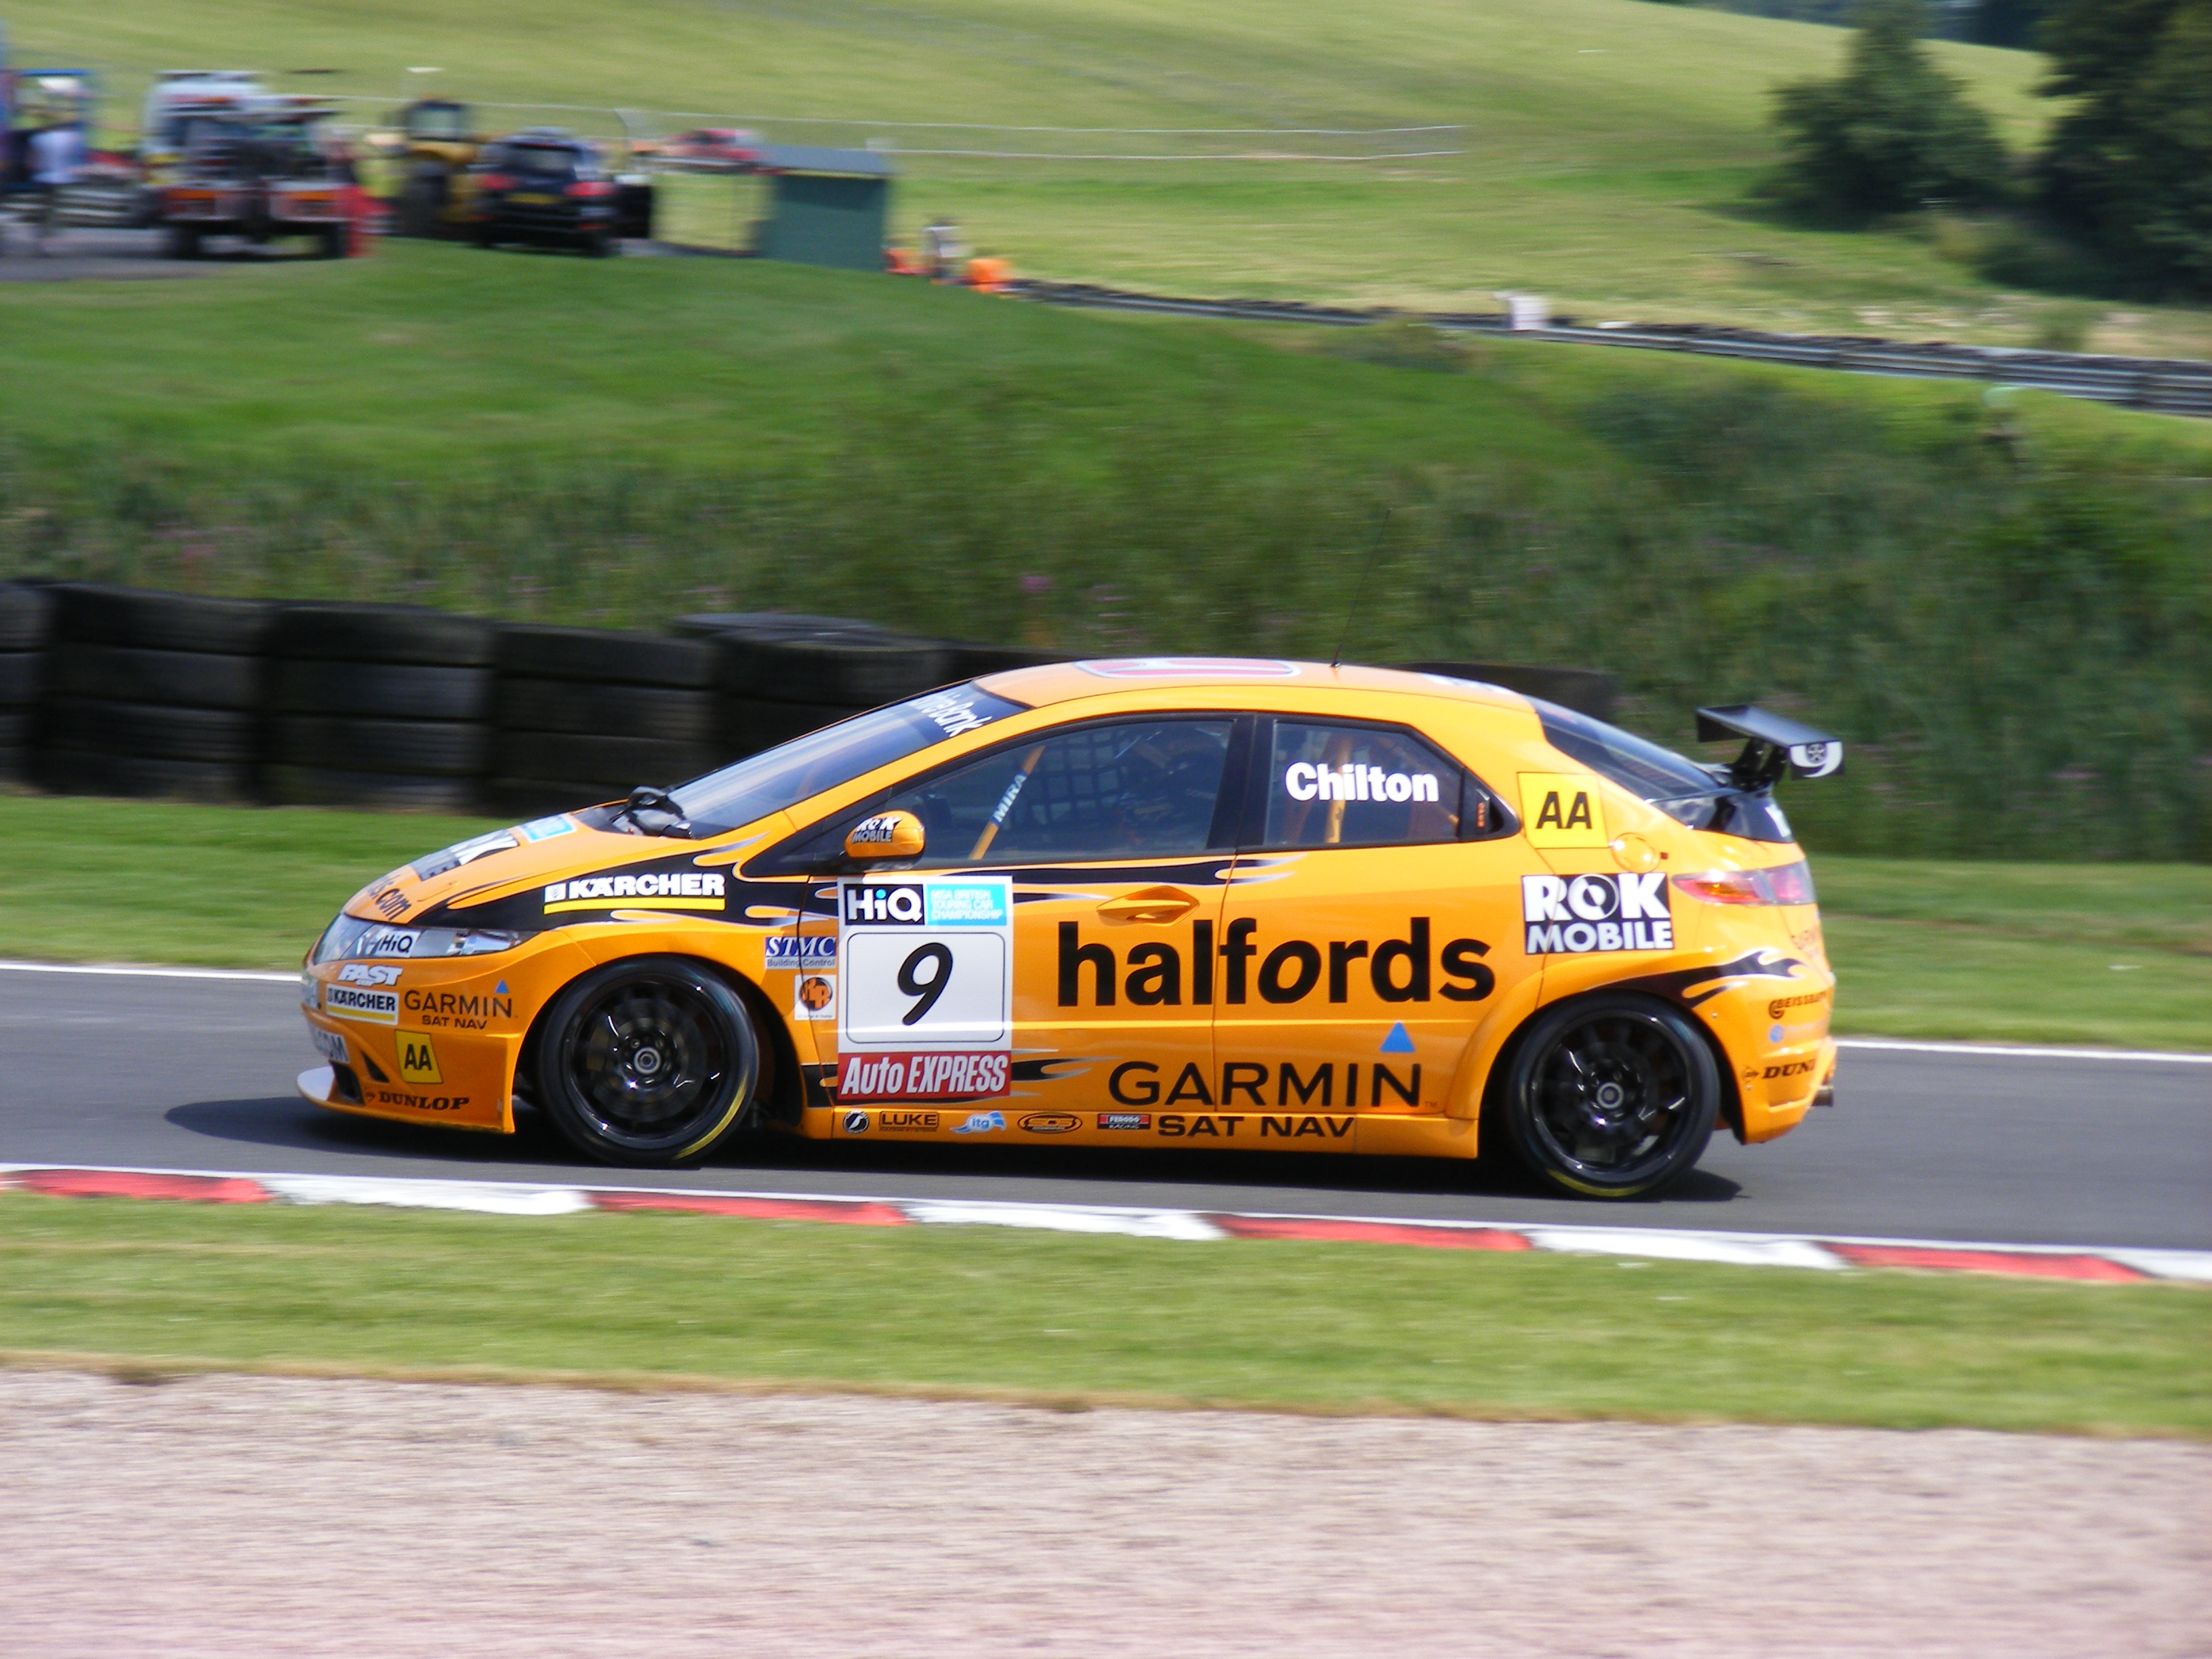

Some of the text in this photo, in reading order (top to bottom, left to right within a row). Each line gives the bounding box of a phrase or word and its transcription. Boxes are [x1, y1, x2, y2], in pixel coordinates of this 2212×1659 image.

[1286, 762, 1439, 802] Chilton
[993, 775, 1027, 823] MIRA
[1535, 792, 1593, 829] AA
[853, 830, 893, 843] MOBILE
[847, 888, 923, 922] HiQ
[931, 900, 972, 909] TOURING
[954, 889, 991, 899] BRITISH
[973, 899, 994, 909] CAR
[1523, 872, 1671, 921] ROK
[931, 909, 1003, 920] CHAMPIONSHIP
[378, 935, 413, 953] HiQ
[766, 937, 836, 956] STMC
[1526, 921, 1673, 954] MOBILE
[767, 958, 834, 968] Building Control
[1057, 917, 1496, 1007] halfords
[337, 964, 403, 986] FAST
[898, 942, 953, 1026] 9
[405, 990, 512, 1018] GARMIN
[422, 1015, 487, 1029] SAT NAV
[405, 1044, 432, 1071] AA
[840, 1054, 1008, 1095] Auto EXPRESS
[1109, 1061, 1421, 1107] GARMIN
[379, 1091, 470, 1110] DUNLOP
[882, 1113, 937, 1126] LUKE
[1158, 1116, 1354, 1137] SAT NAV
